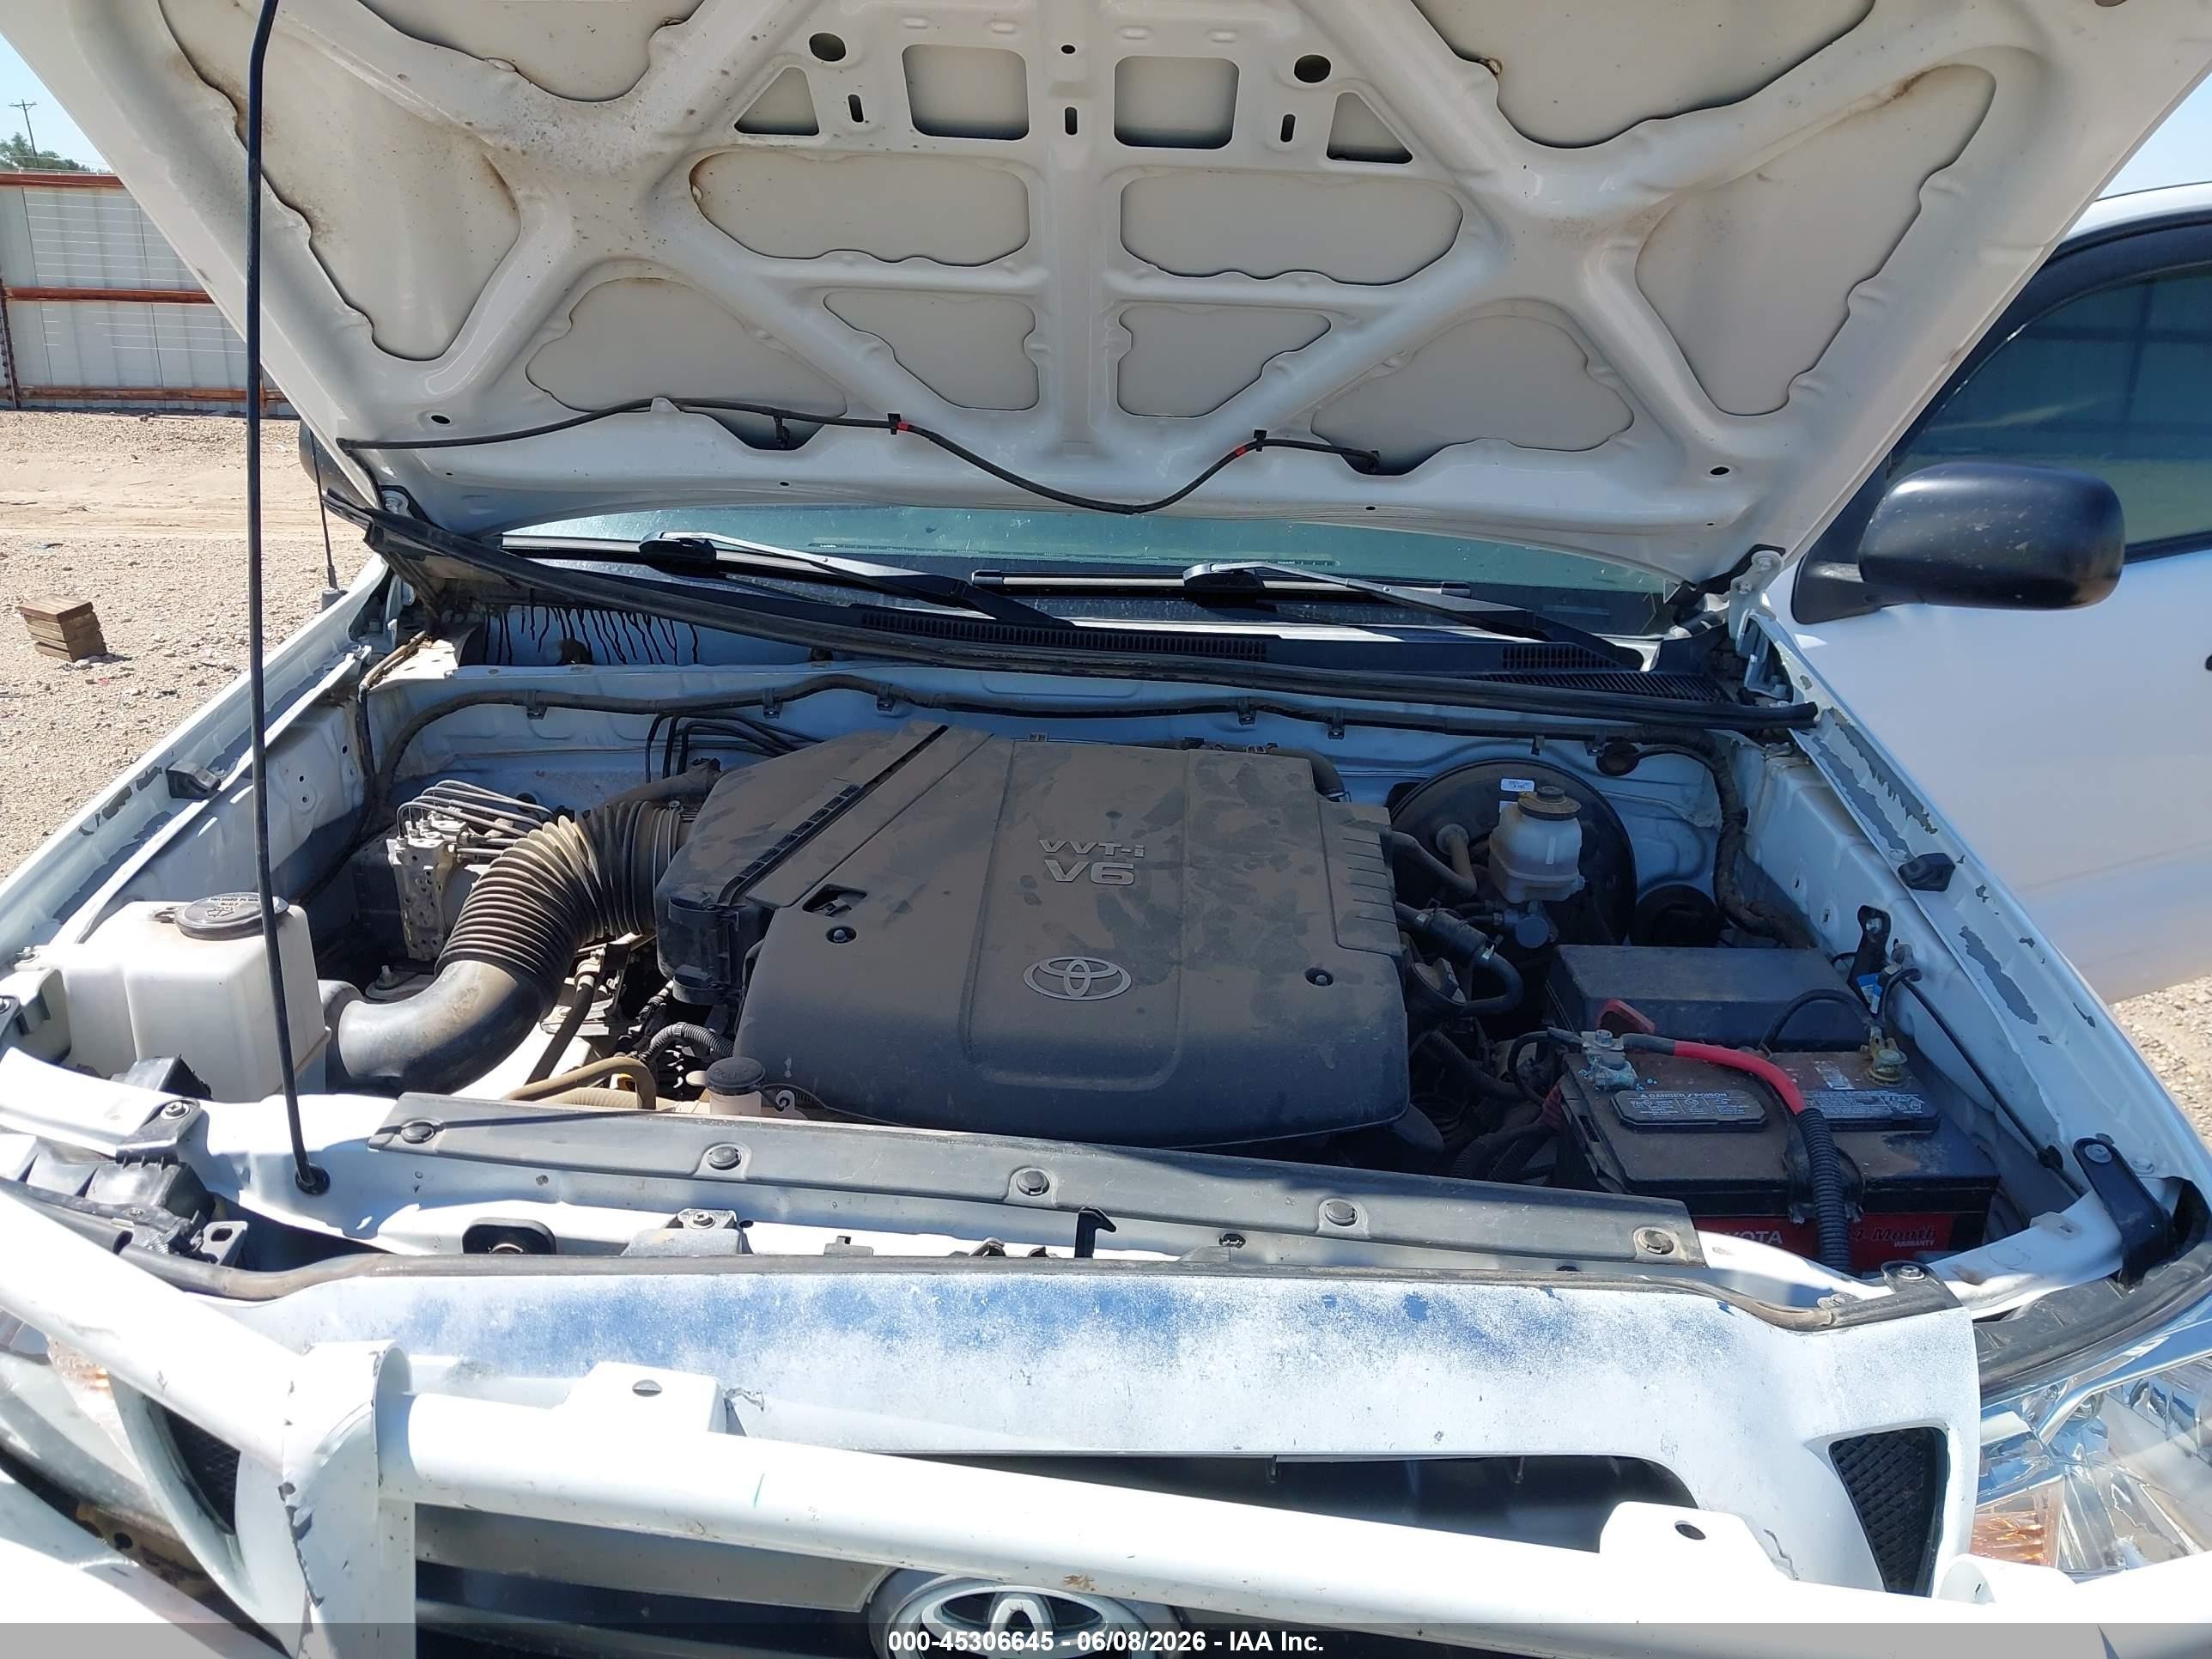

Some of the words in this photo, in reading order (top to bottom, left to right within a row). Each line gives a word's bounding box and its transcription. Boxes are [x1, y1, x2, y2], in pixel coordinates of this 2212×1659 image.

[1039, 839, 1146, 858] VVT-i
[1044, 859, 1134, 885] V6
[1871, 1225, 1937, 1242] Month
